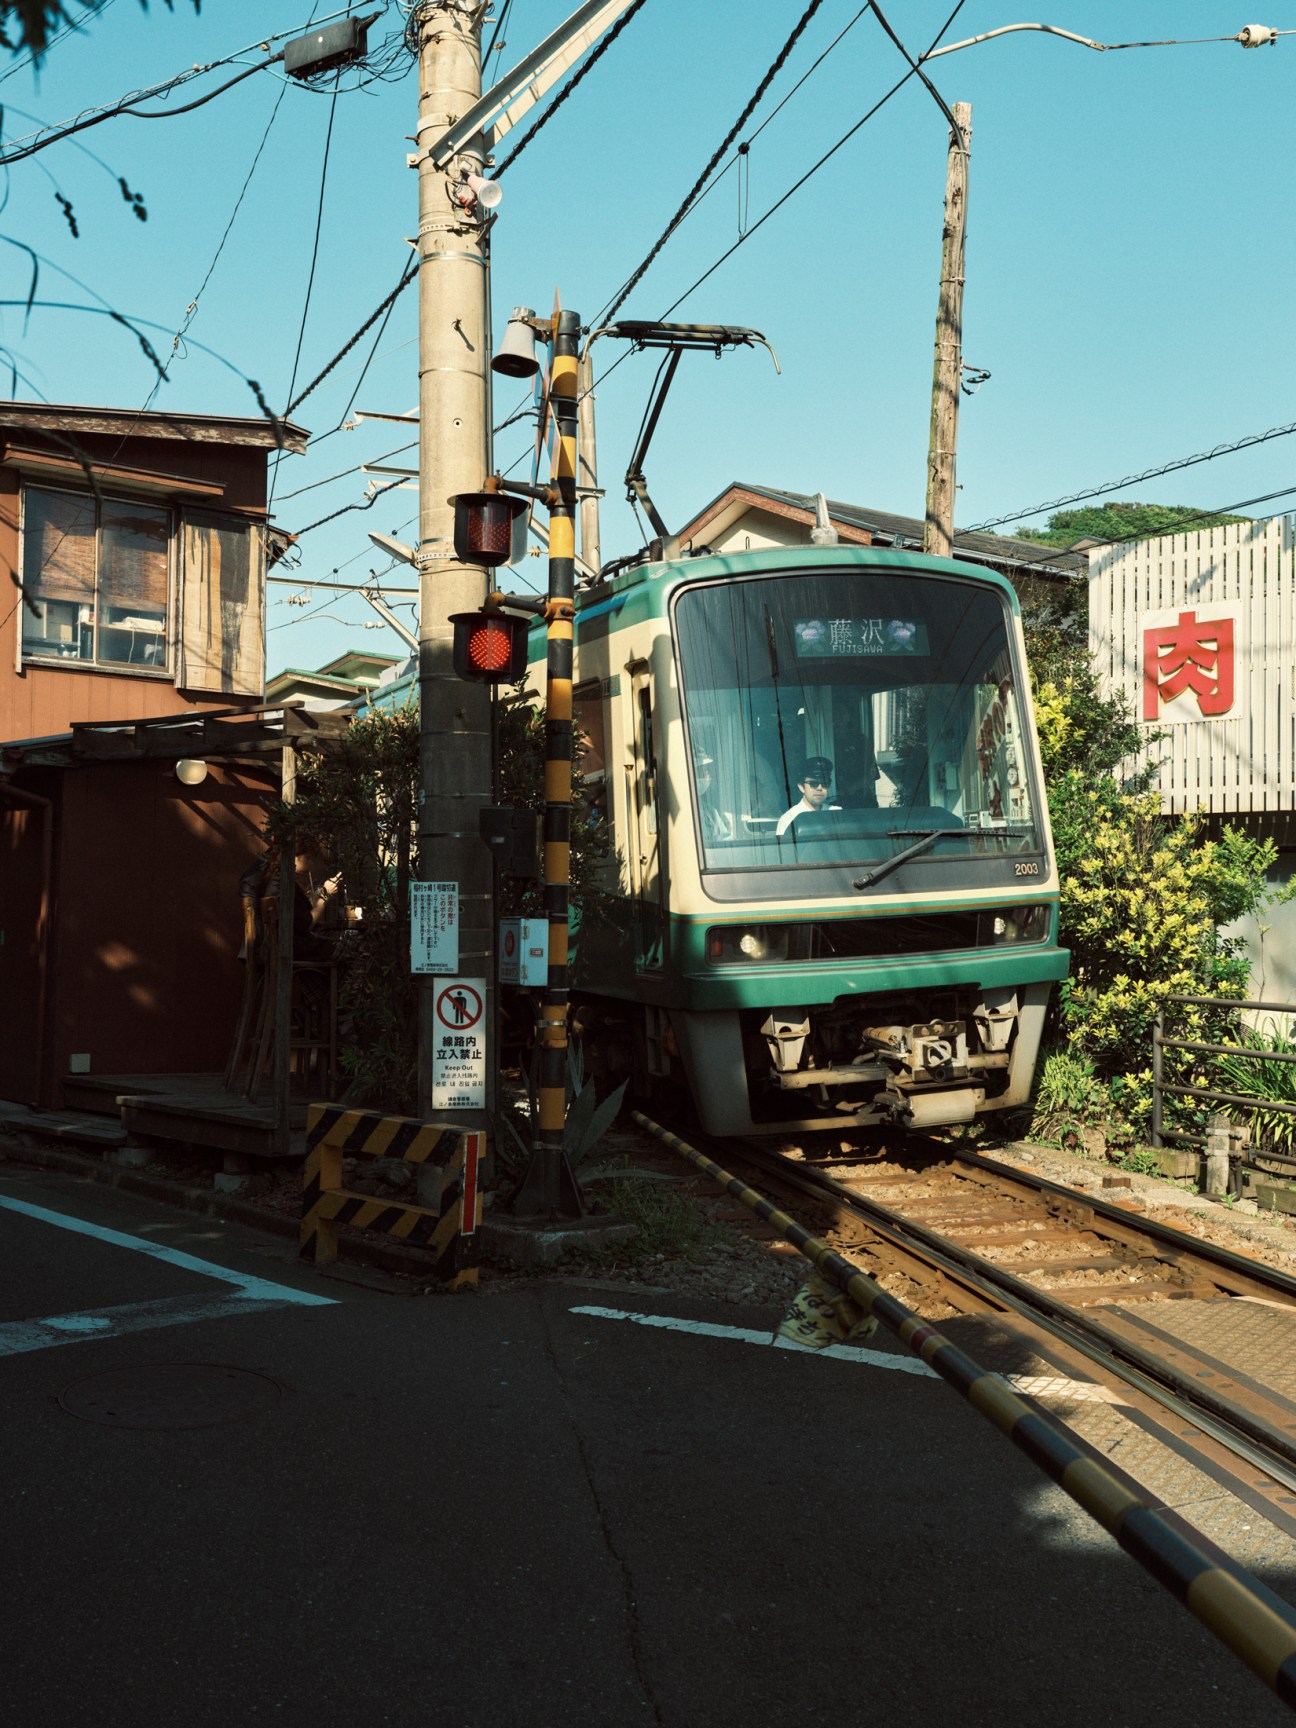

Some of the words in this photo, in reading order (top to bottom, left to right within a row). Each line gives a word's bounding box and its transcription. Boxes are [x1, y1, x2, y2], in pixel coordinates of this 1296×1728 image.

[828, 619, 884, 645] 藤沢
[832, 645, 883, 654] FUJISAWA
[1143, 611, 1234, 720] 肉
[1015, 862, 1038, 875] 2003
[442, 1036, 476, 1046] 線路内
[436, 1049, 482, 1059] 立入禁止
